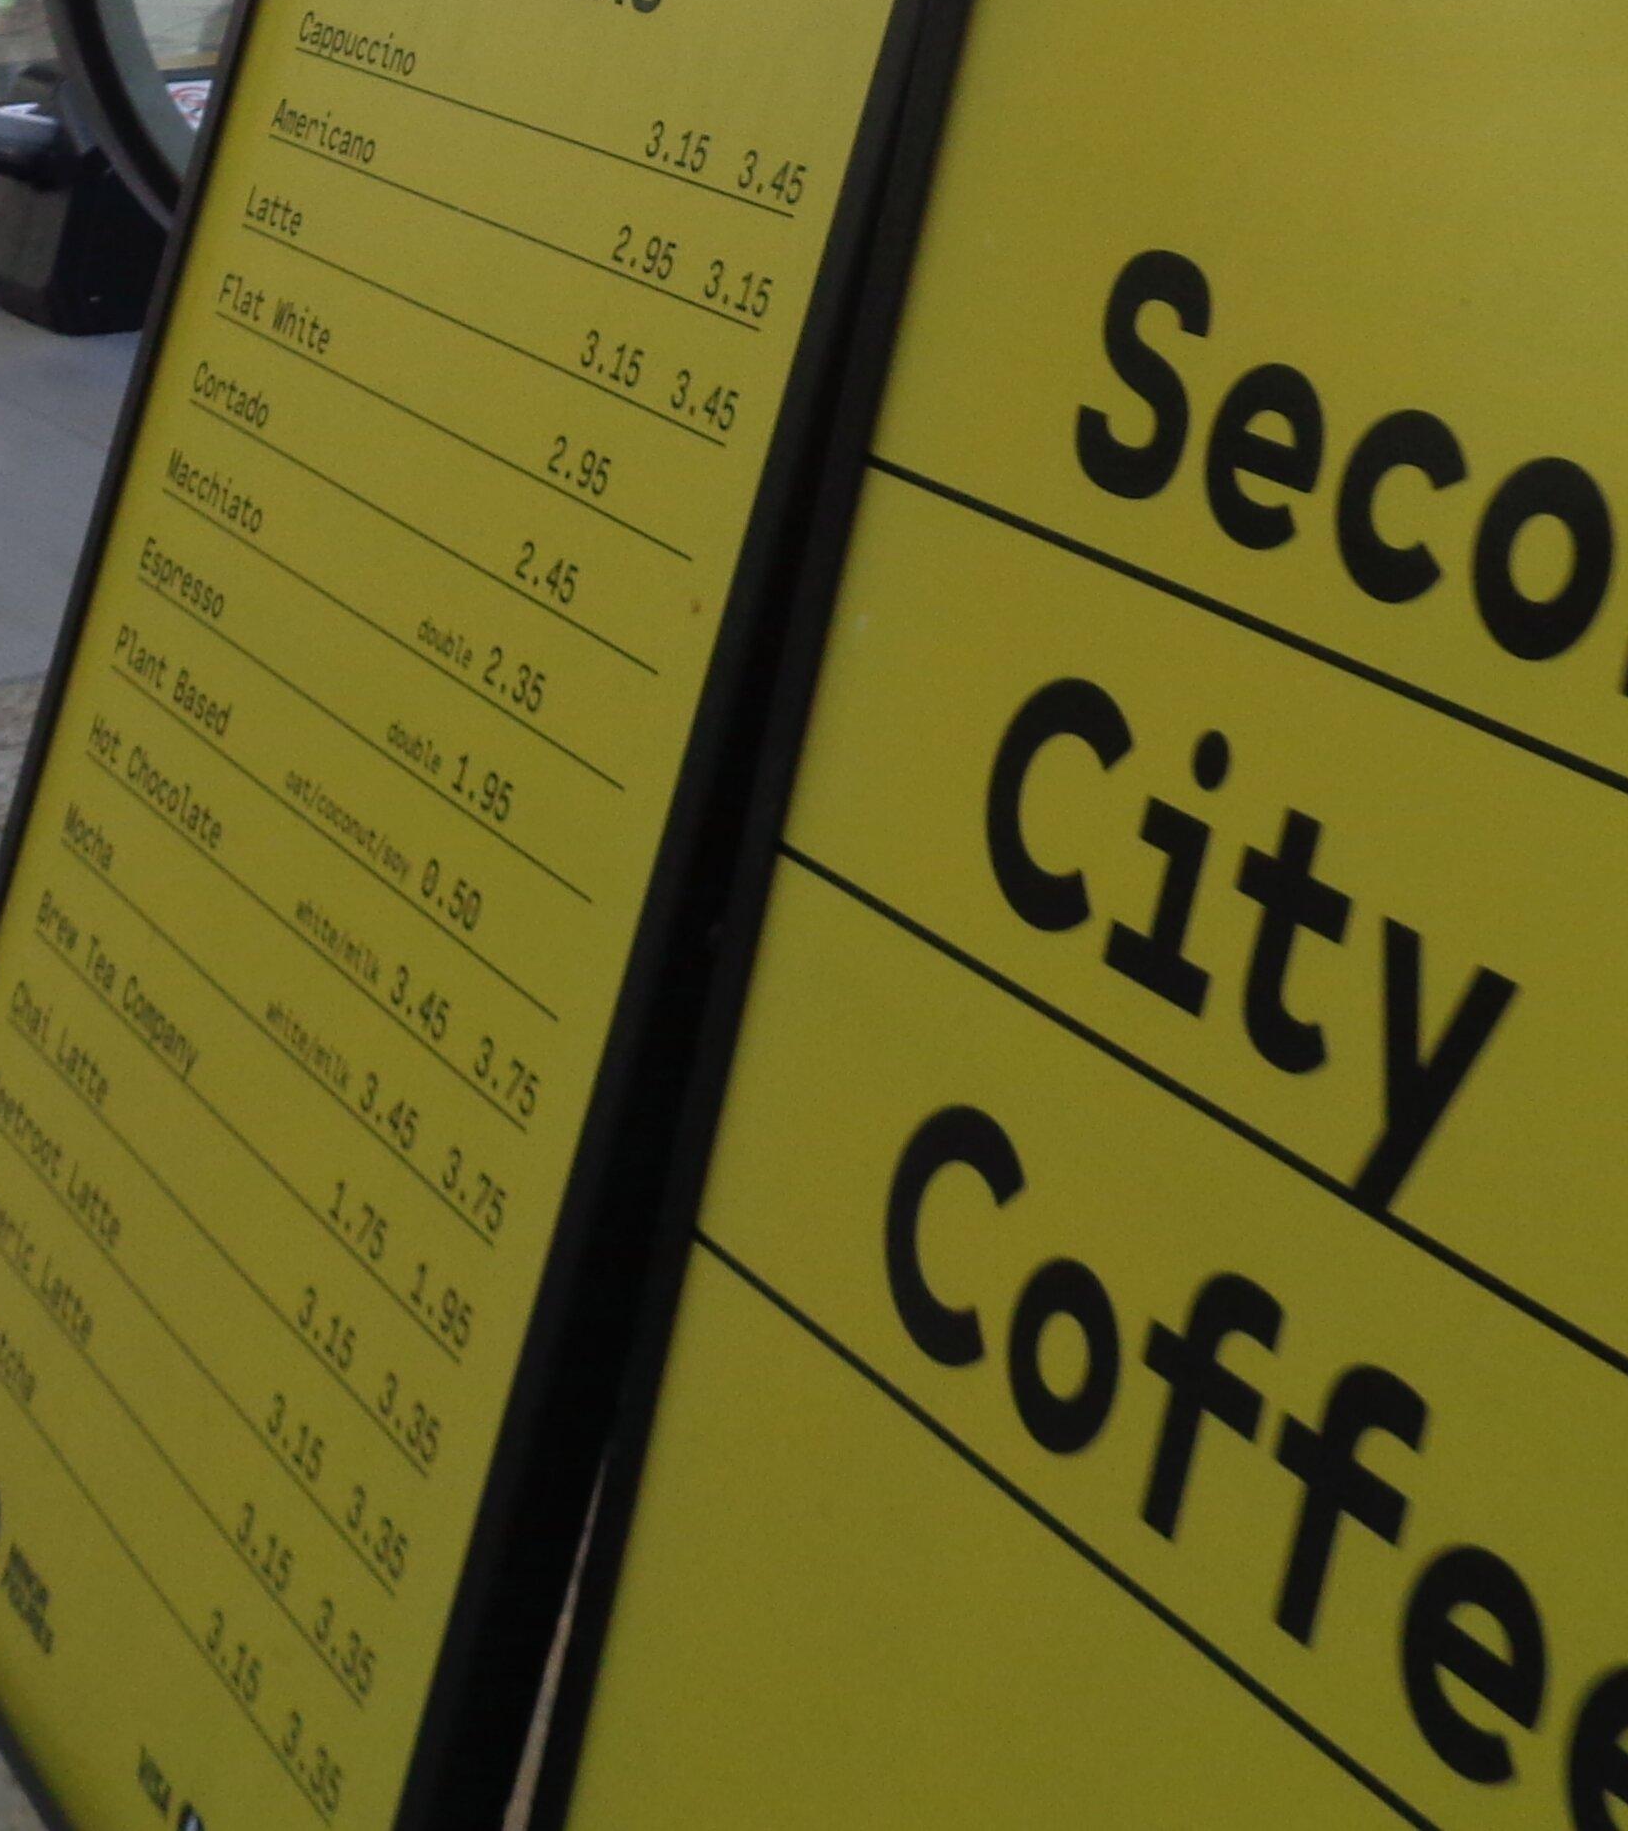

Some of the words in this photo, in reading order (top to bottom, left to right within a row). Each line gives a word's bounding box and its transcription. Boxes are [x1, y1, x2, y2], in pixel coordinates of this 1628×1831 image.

[271, 98, 377, 165] Americano
[610, 224, 678, 282] 2.95
[703, 258, 774, 319] 3.15
[298, 11, 417, 77] Cappuccino
[644, 119, 712, 174] 3.15
[737, 149, 808, 206] 3.45
[218, 272, 266, 323] Flat
[271, 298, 331, 356] White
[546, 434, 612, 498] 2.95
[245, 186, 303, 238] Latte
[579, 328, 645, 389] 3.15
[670, 368, 740, 433] 3.45
[166, 450, 264, 535] Macchiato
[482, 645, 547, 715] 2.35
[193, 360, 270, 430] Cortado
[514, 539, 580, 606] 2.45
[114, 624, 168, 691] Plant
[172, 667, 233, 738] Based
[139, 536, 225, 619] Espresso
[451, 754, 515, 824] 1.95
[89, 718, 122, 765] Hot
[126, 744, 223, 851] Chocolate
[389, 964, 451, 1043] 3.45
[473, 1034, 541, 1118] 3.75
[983, 675, 1522, 1216] City
[85, 934, 118, 994] Tea
[122, 975, 200, 1083] Company
[327, 1179, 389, 1262] 1.75
[409, 1262, 474, 1350] 1.95
[359, 1071, 420, 1152] 3.45
[441, 1146, 507, 1234] 3.75
